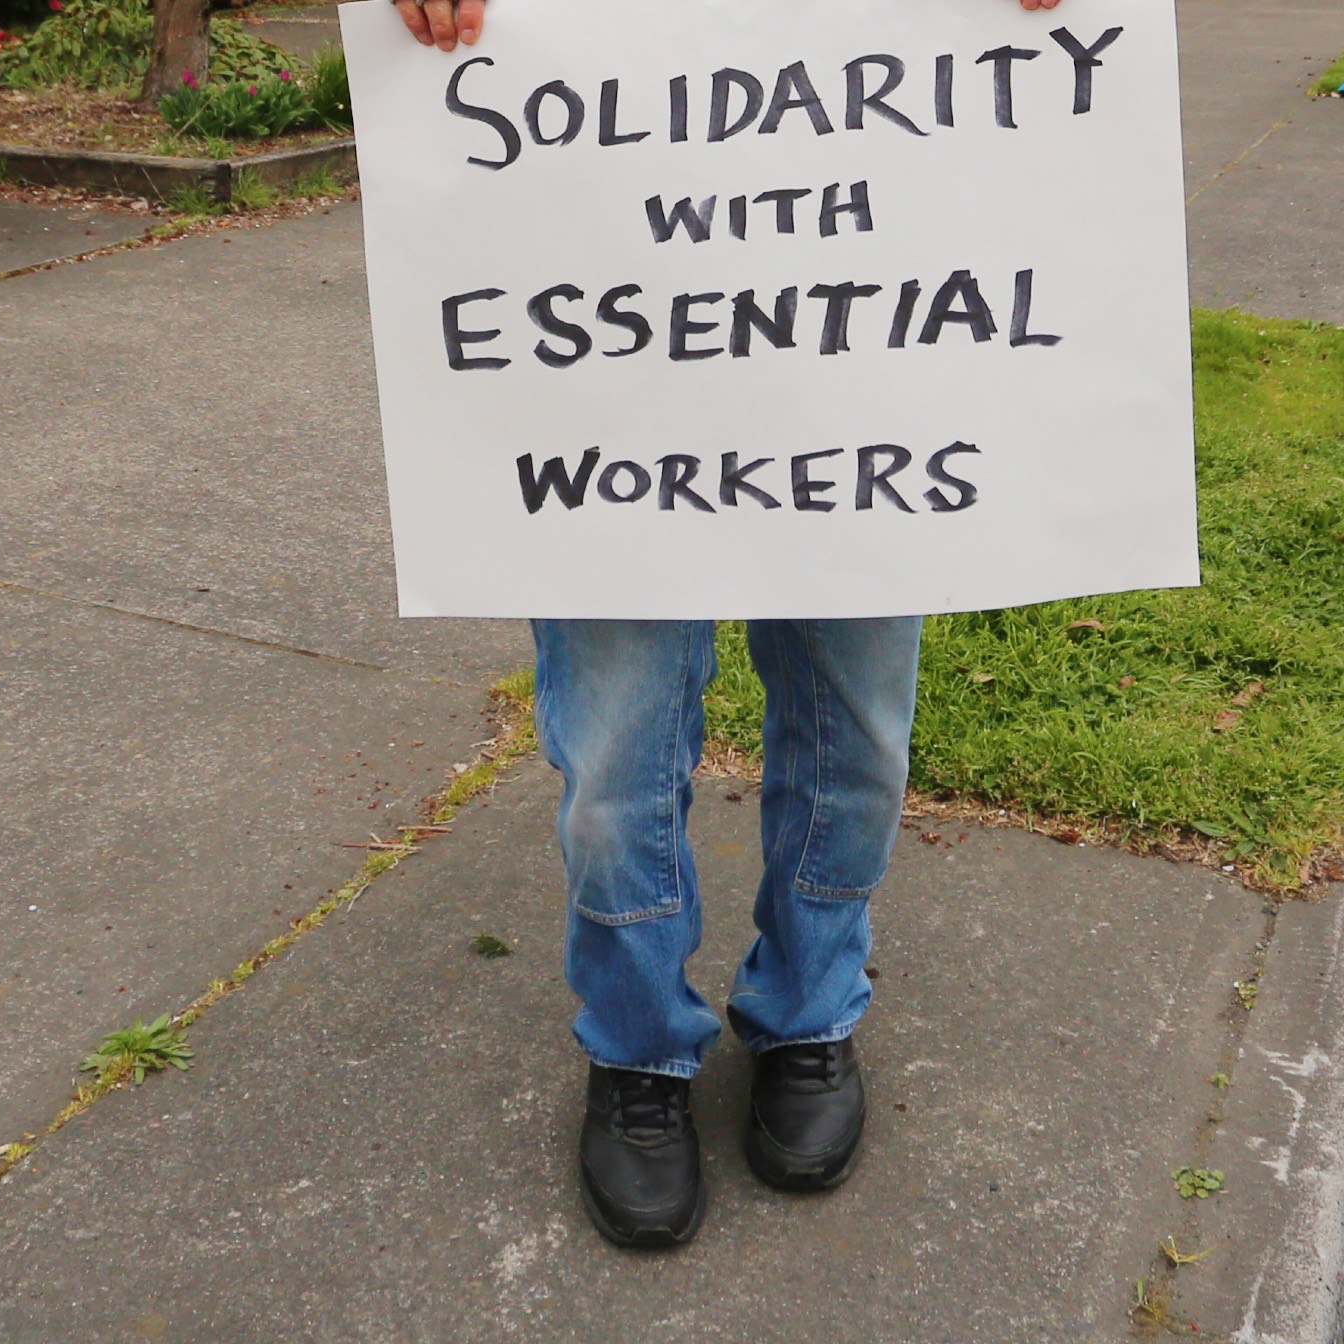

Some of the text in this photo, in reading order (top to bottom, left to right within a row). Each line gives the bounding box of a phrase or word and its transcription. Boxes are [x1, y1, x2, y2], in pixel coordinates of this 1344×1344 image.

[445, 26, 1124, 171] SOLIDARITY
[645, 180, 874, 243] WITH
[441, 268, 1063, 372] ESSENTIAL
[516, 441, 982, 515] WORKERS
